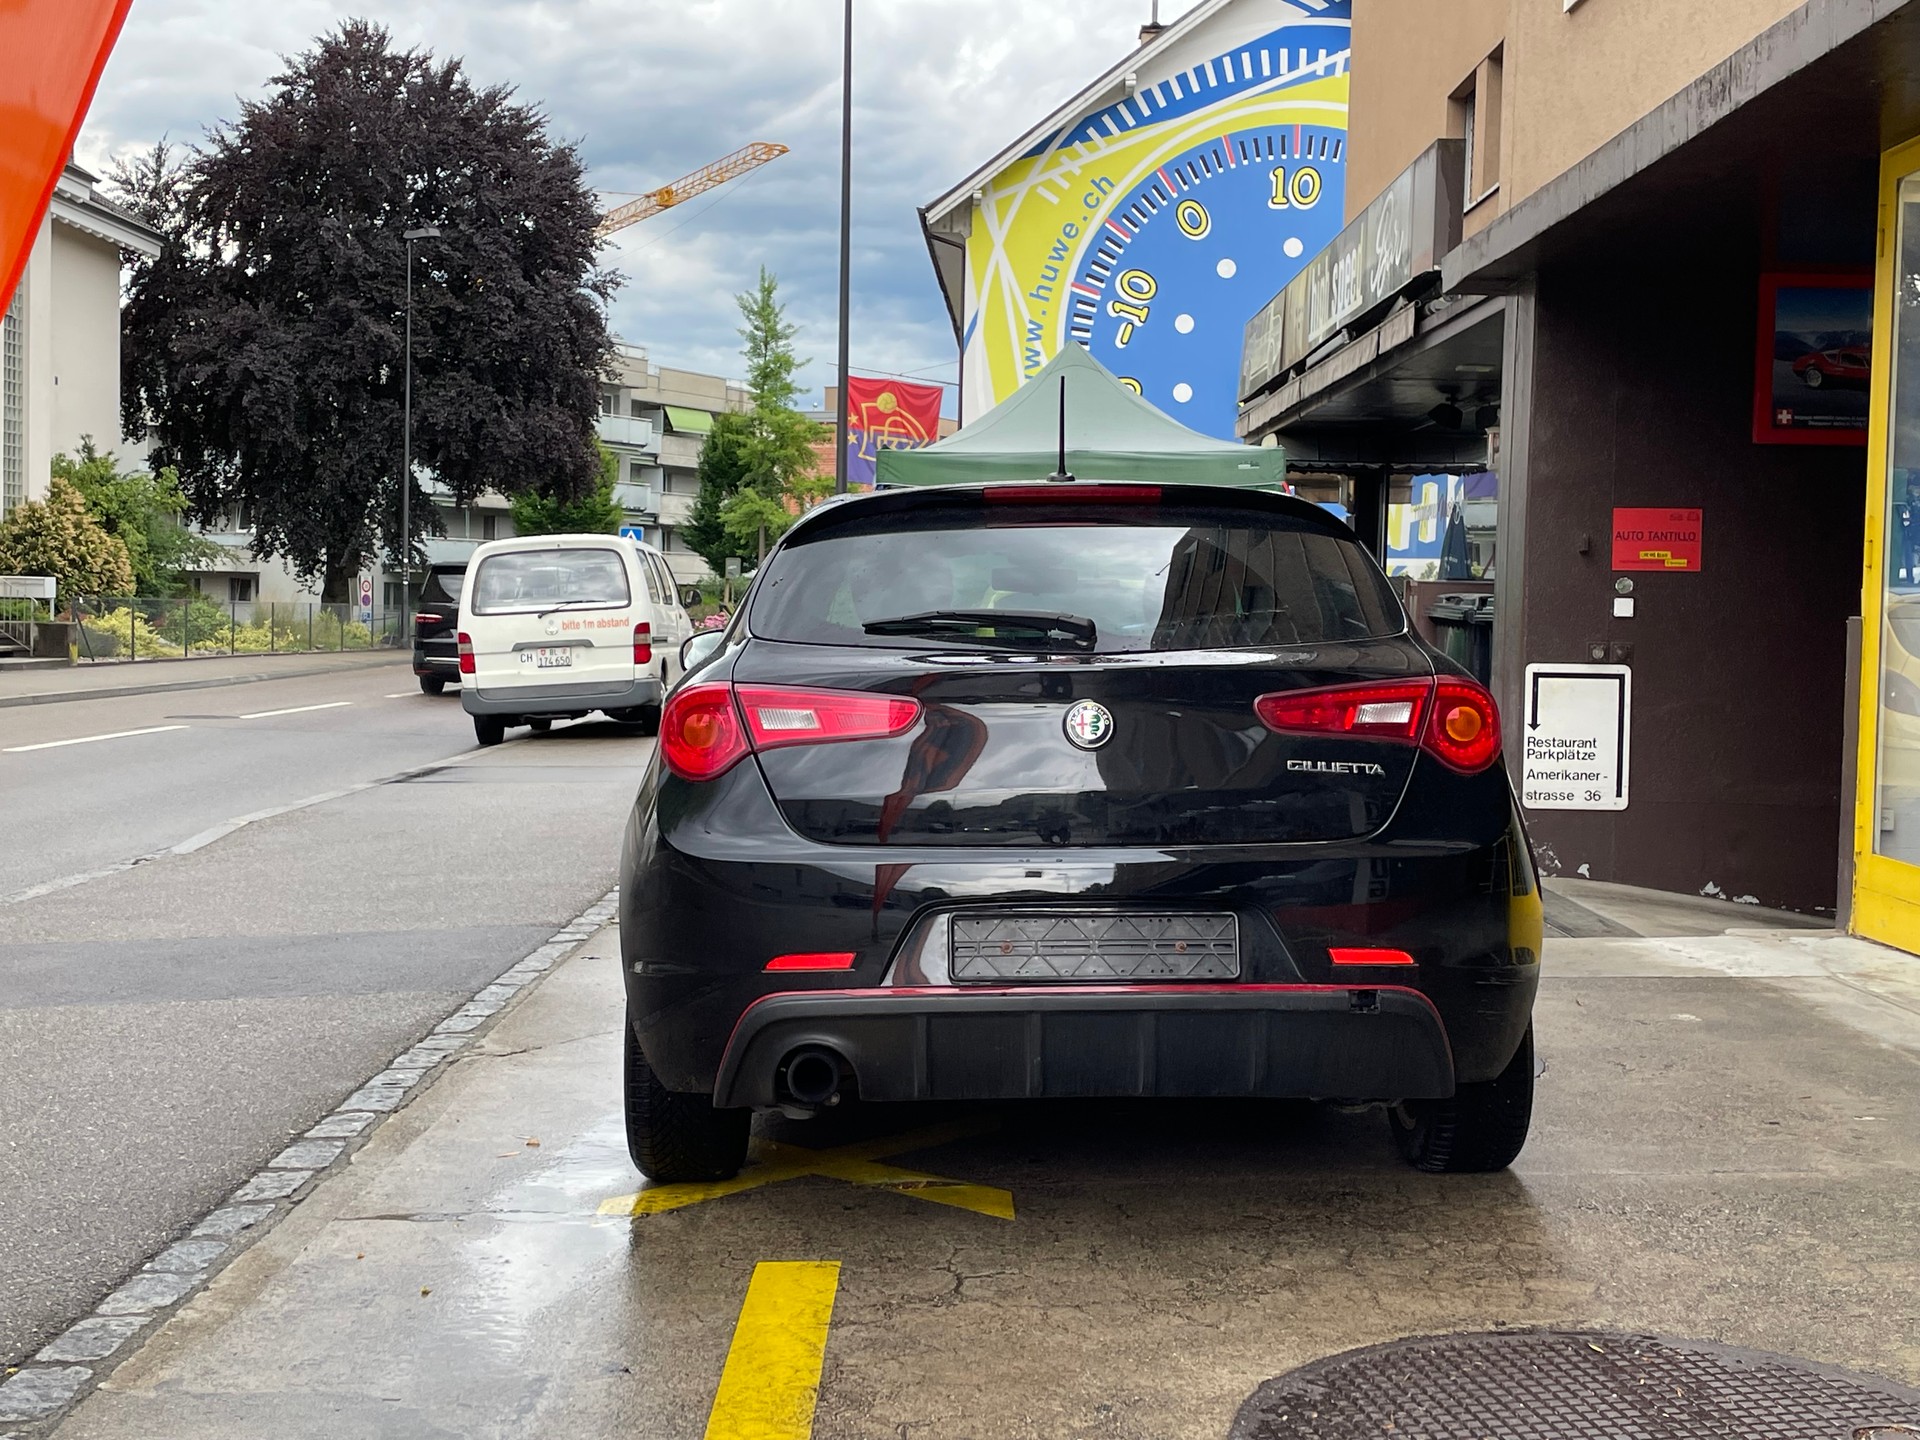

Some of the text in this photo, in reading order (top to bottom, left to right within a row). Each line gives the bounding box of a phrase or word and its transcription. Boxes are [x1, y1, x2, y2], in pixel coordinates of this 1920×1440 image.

[1270, 166, 1322, 208] 10
[1174, 198, 1212, 241] 0
[1024, 175, 1116, 380] ww.huwe.ch
[1332, 222, 1364, 329] speed
[1107, 268, 1159, 349] -10
[1615, 530, 1697, 542] AUTO TANTILLO
[562, 617, 630, 631] bitte 1m abstand
[520, 654, 533, 663] CH
[1526, 736, 1598, 749] Restaurant
[1526, 748, 1597, 762] Parkplätze
[1286, 758, 1386, 776] GIULIETTA
[1525, 789, 1602, 802] strasse 36
